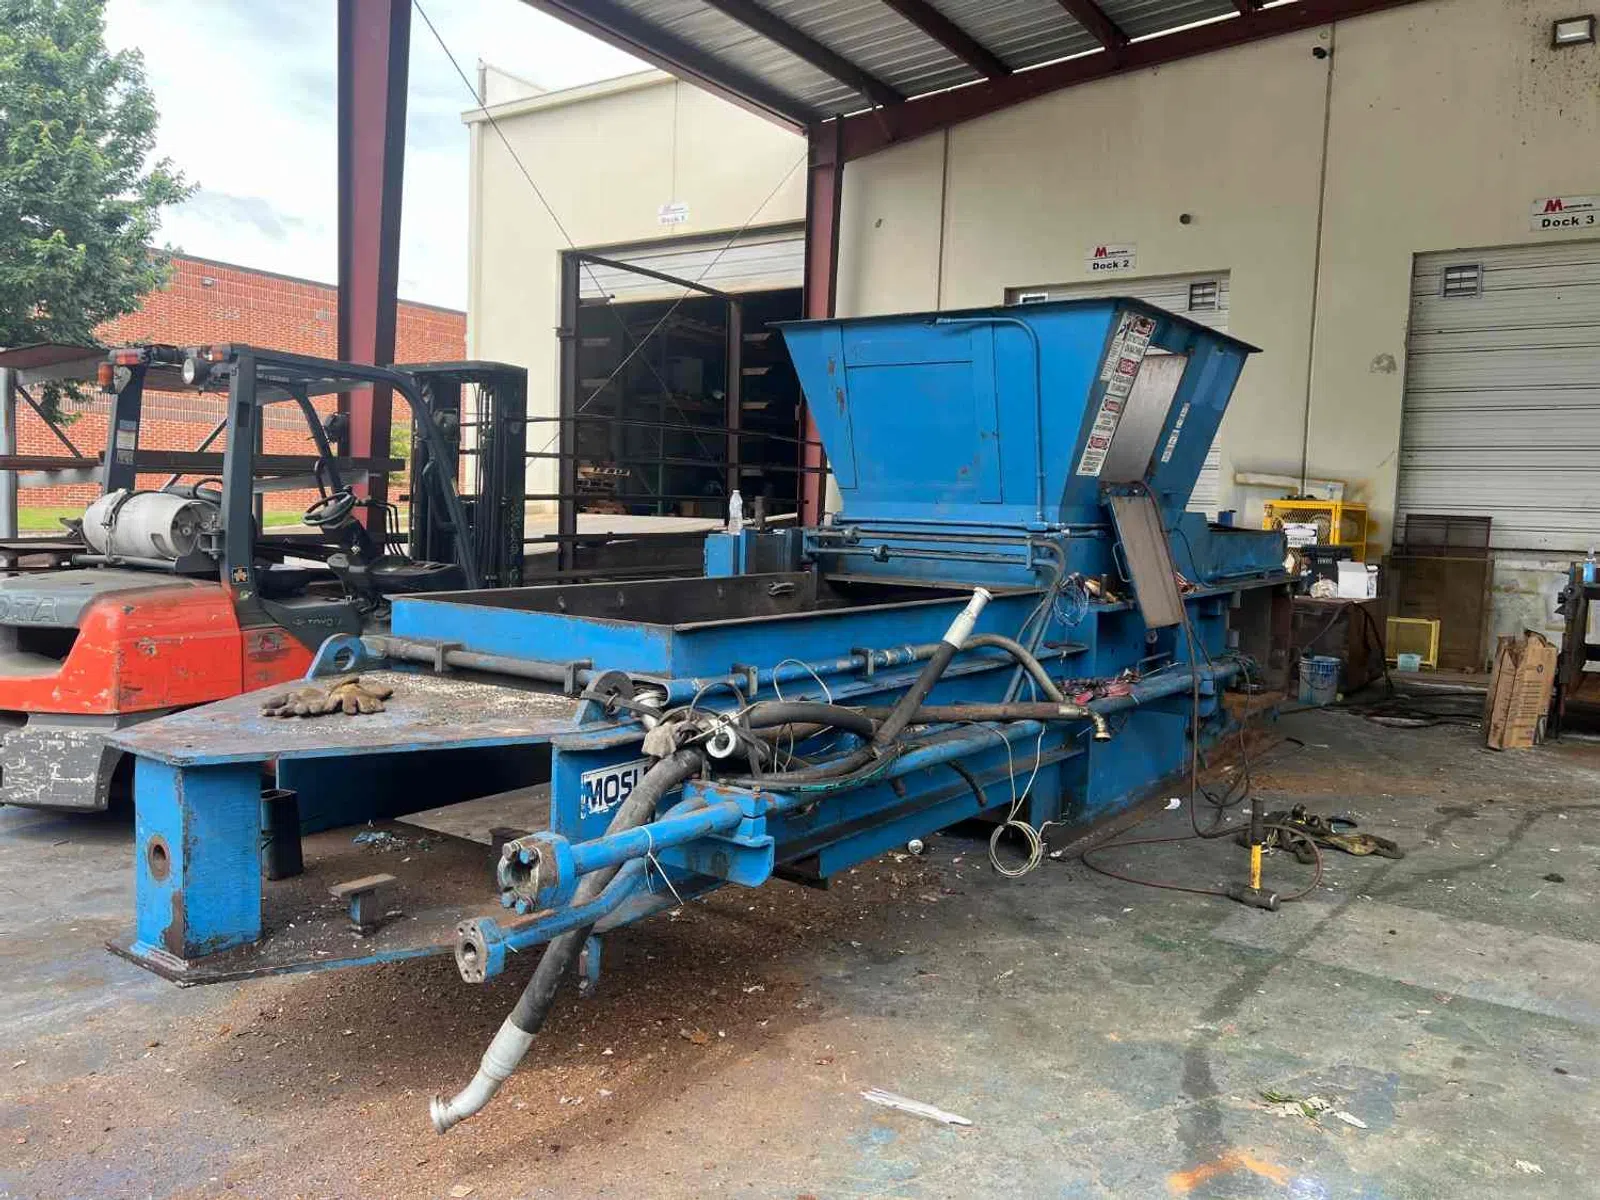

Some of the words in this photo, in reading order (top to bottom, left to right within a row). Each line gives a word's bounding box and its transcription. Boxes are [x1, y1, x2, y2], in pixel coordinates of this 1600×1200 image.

[1541, 216, 1580, 228] Dock
[1586, 215, 1595, 224] 3
[1092, 260, 1119, 270] Dock
[1123, 259, 1130, 268] 2
